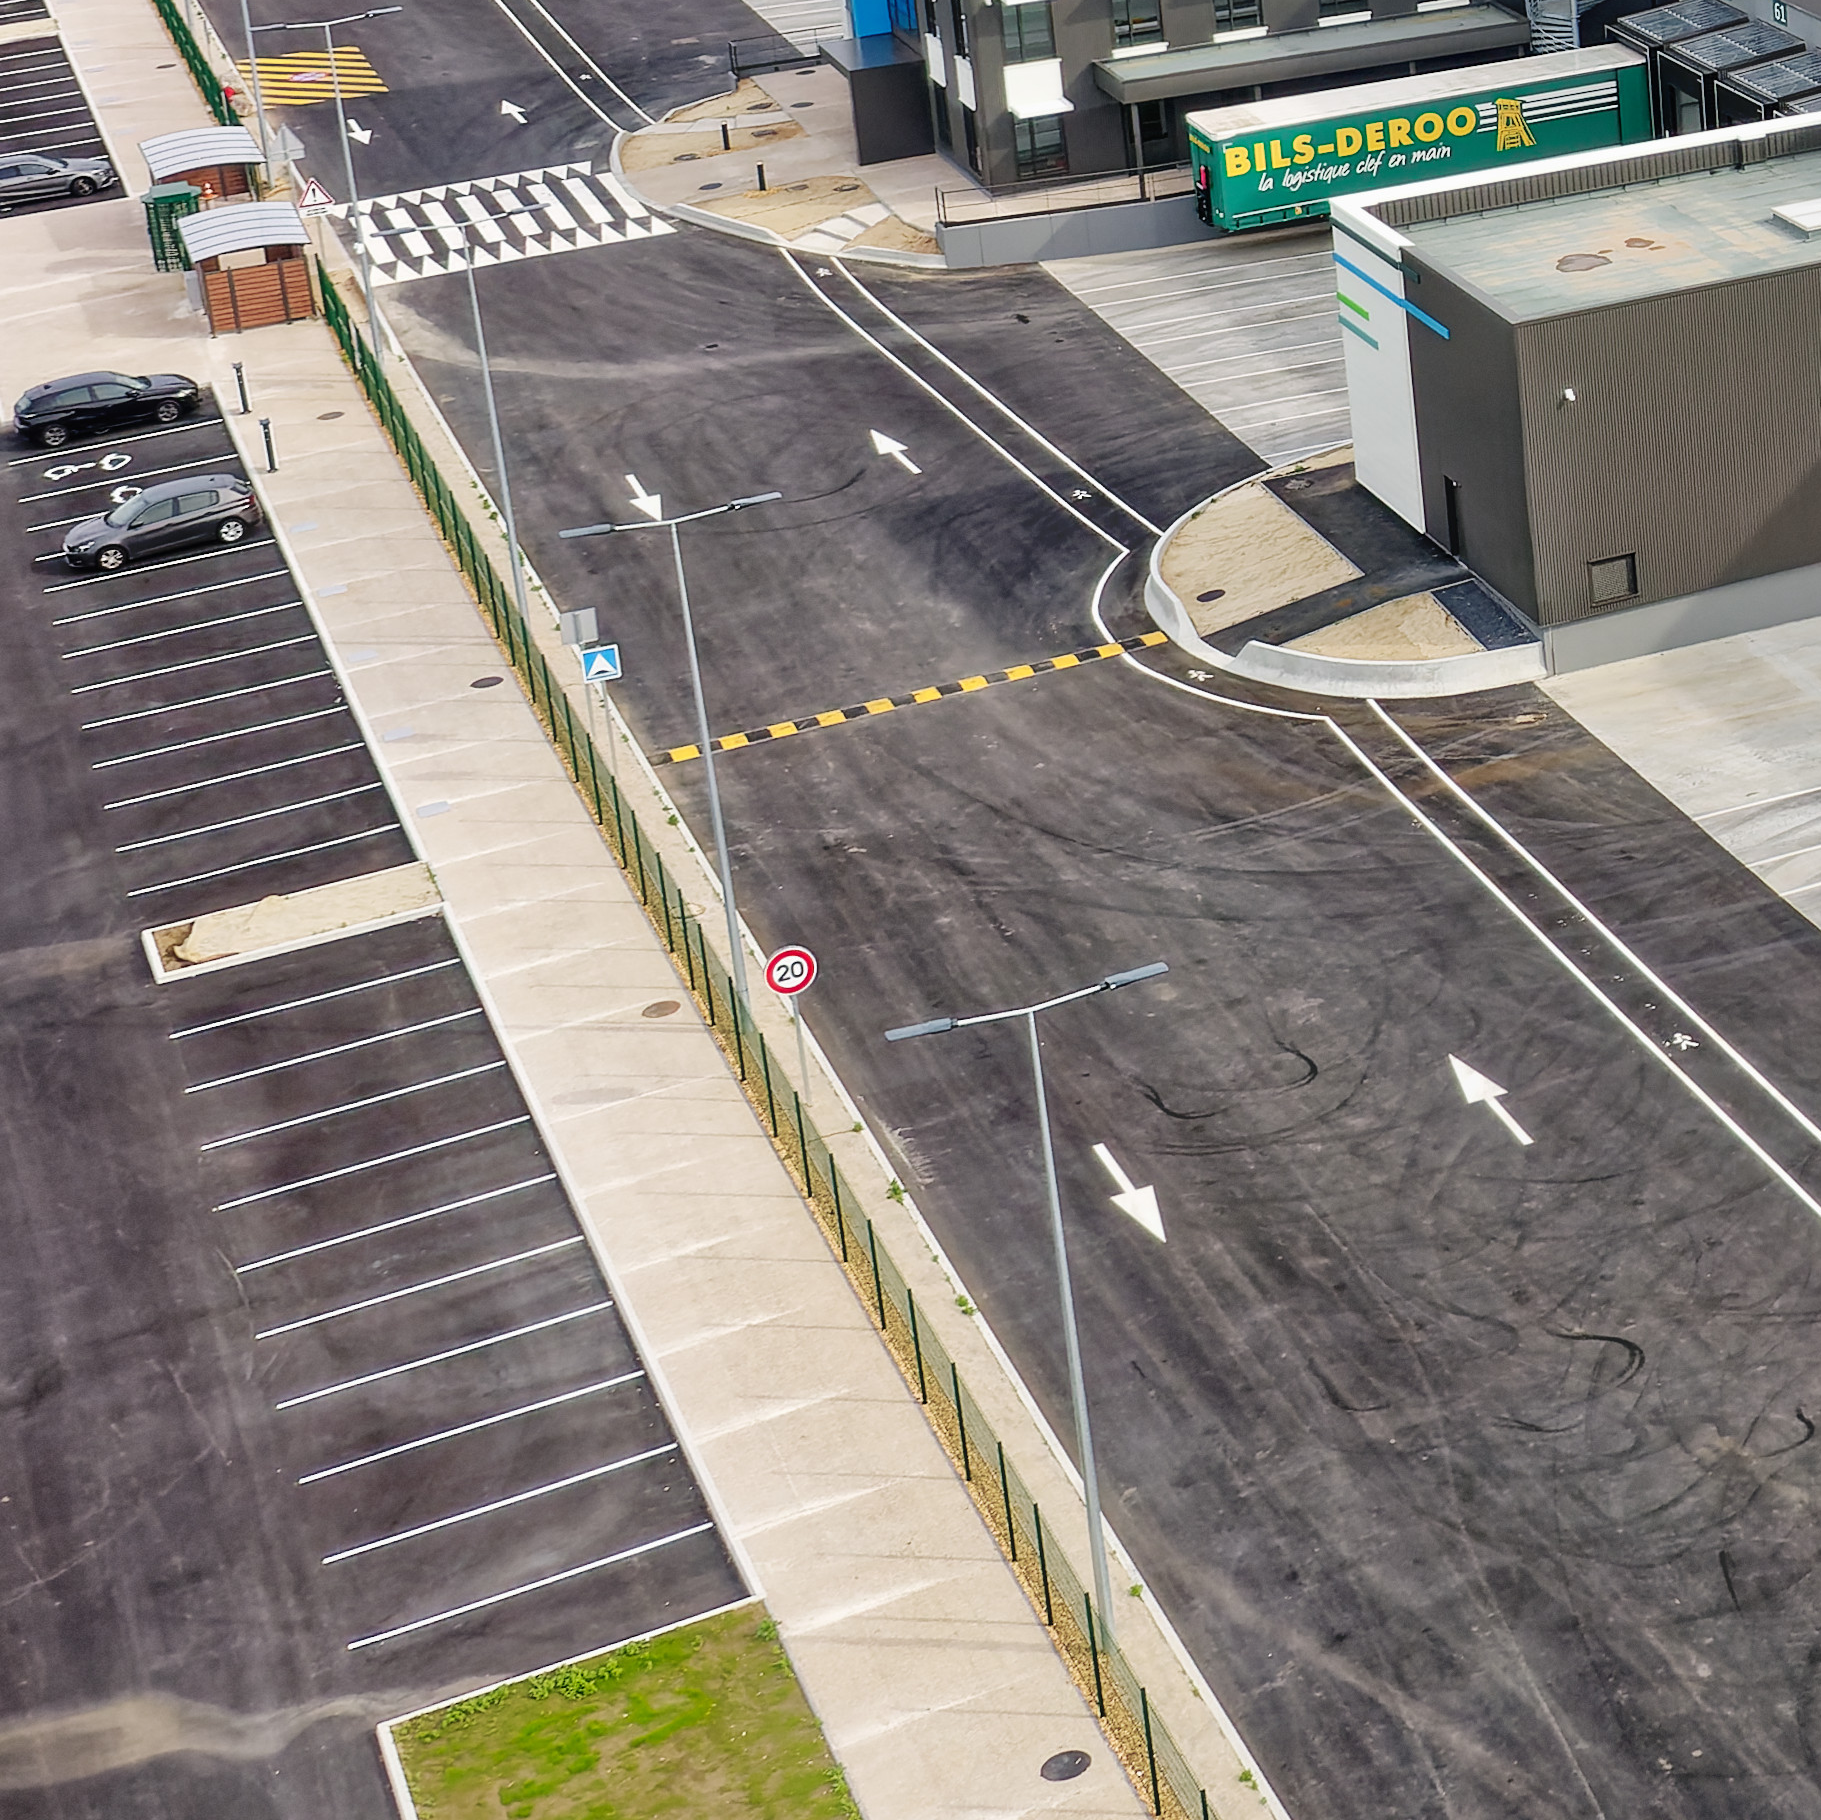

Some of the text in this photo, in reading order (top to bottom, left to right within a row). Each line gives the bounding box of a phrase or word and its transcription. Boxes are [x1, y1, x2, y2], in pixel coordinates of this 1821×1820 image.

[1774, 2, 1787, 23] 61
[1224, 106, 1477, 178] BILS-DEROO
[1282, 162, 1350, 192] logistique
[1356, 150, 1386, 177] clef
[1388, 150, 1406, 168] en
[1411, 142, 1451, 164] main
[777, 961, 804, 982] 20
